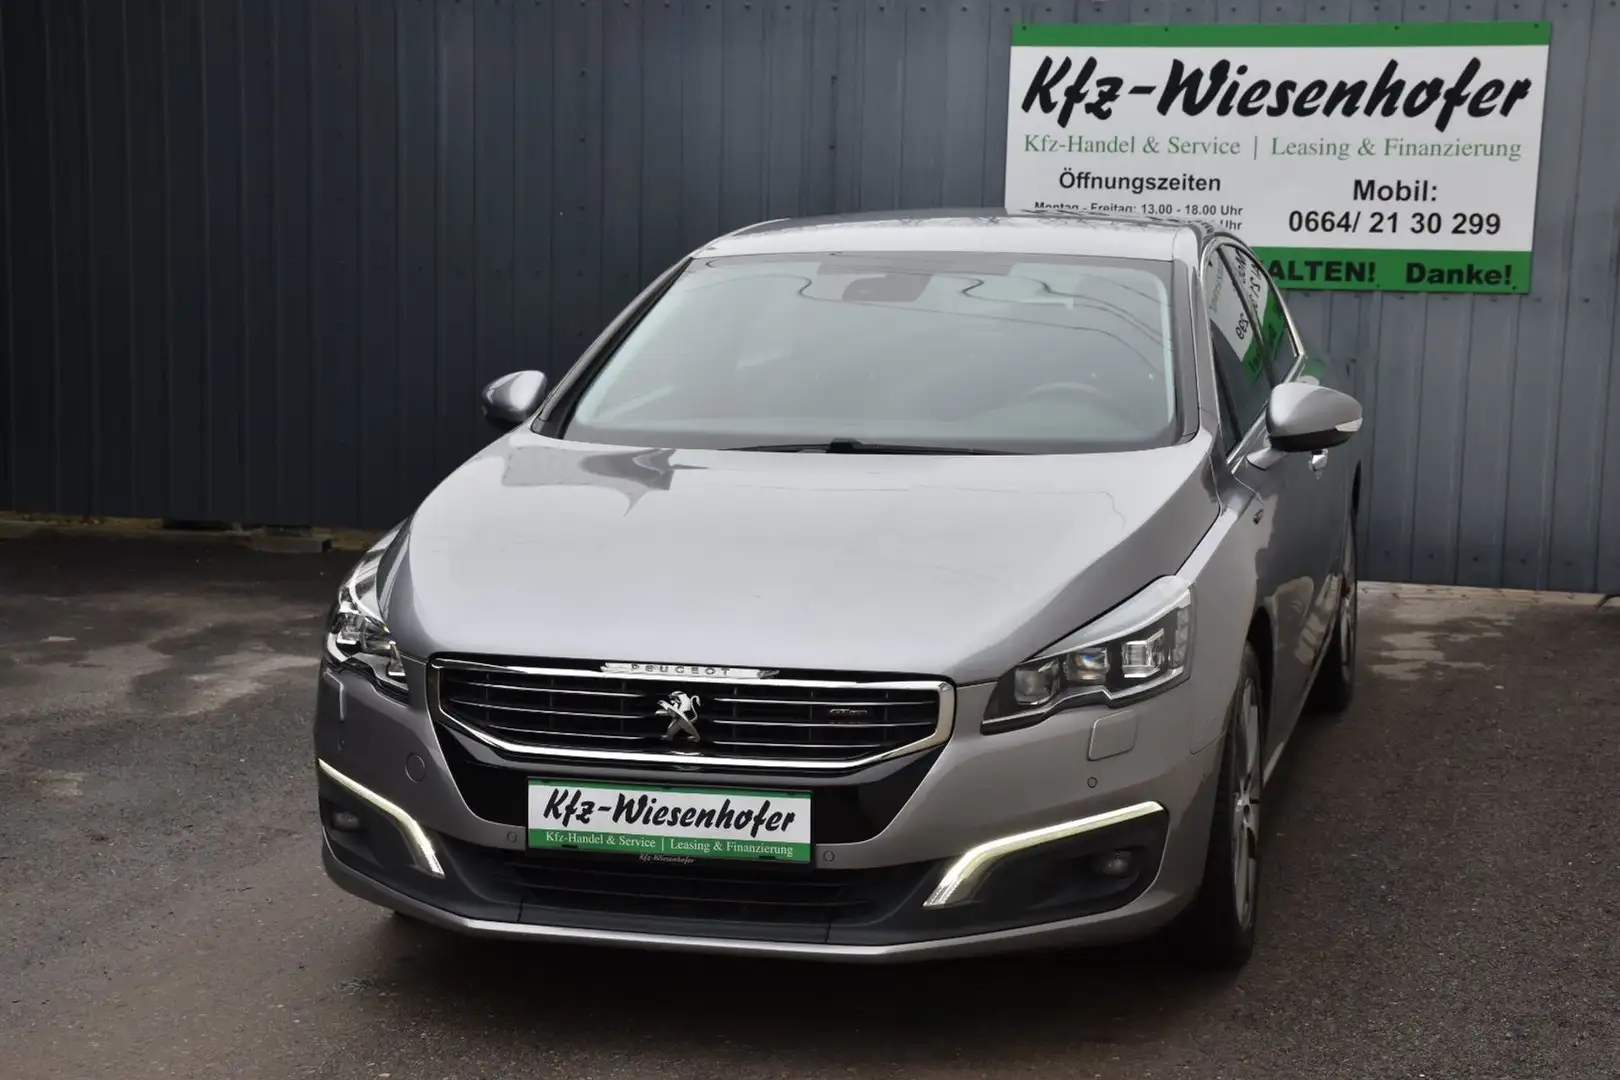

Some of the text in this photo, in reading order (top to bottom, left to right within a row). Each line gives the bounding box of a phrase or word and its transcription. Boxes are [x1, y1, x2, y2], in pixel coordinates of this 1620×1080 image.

[1021, 56, 1532, 133] Kfz-Wiesenhofer
[1024, 134, 1136, 154] Kfz-Handel
[1143, 136, 1160, 154] &
[1167, 137, 1241, 155] Service
[1271, 137, 1350, 160] Leasing
[1357, 138, 1376, 156] &
[1383, 138, 1522, 162] Finanzierung
[1059, 167, 1221, 194] Öffnungszeiten
[1353, 179, 1437, 202] Mobil:
[1141, 203, 1172, 215] 13.00
[1185, 204, 1216, 216] 18.00
[1220, 205, 1243, 216] Uhr
[1288, 210, 1501, 235] 0664/ 21 30 299
[1262, 259, 1512, 286] ALTEN! Danke!
[630, 663, 730, 676] PEUGEOT
[543, 788, 796, 838] Kfz-Wiesenhofer
[546, 831, 604, 845] Kfz-Handel
[606, 835, 616, 845] &
[619, 836, 656, 848] Service
[670, 838, 711, 854] Leasing
[713, 841, 724, 851] &
[726, 842, 794, 858] Finanzierung
